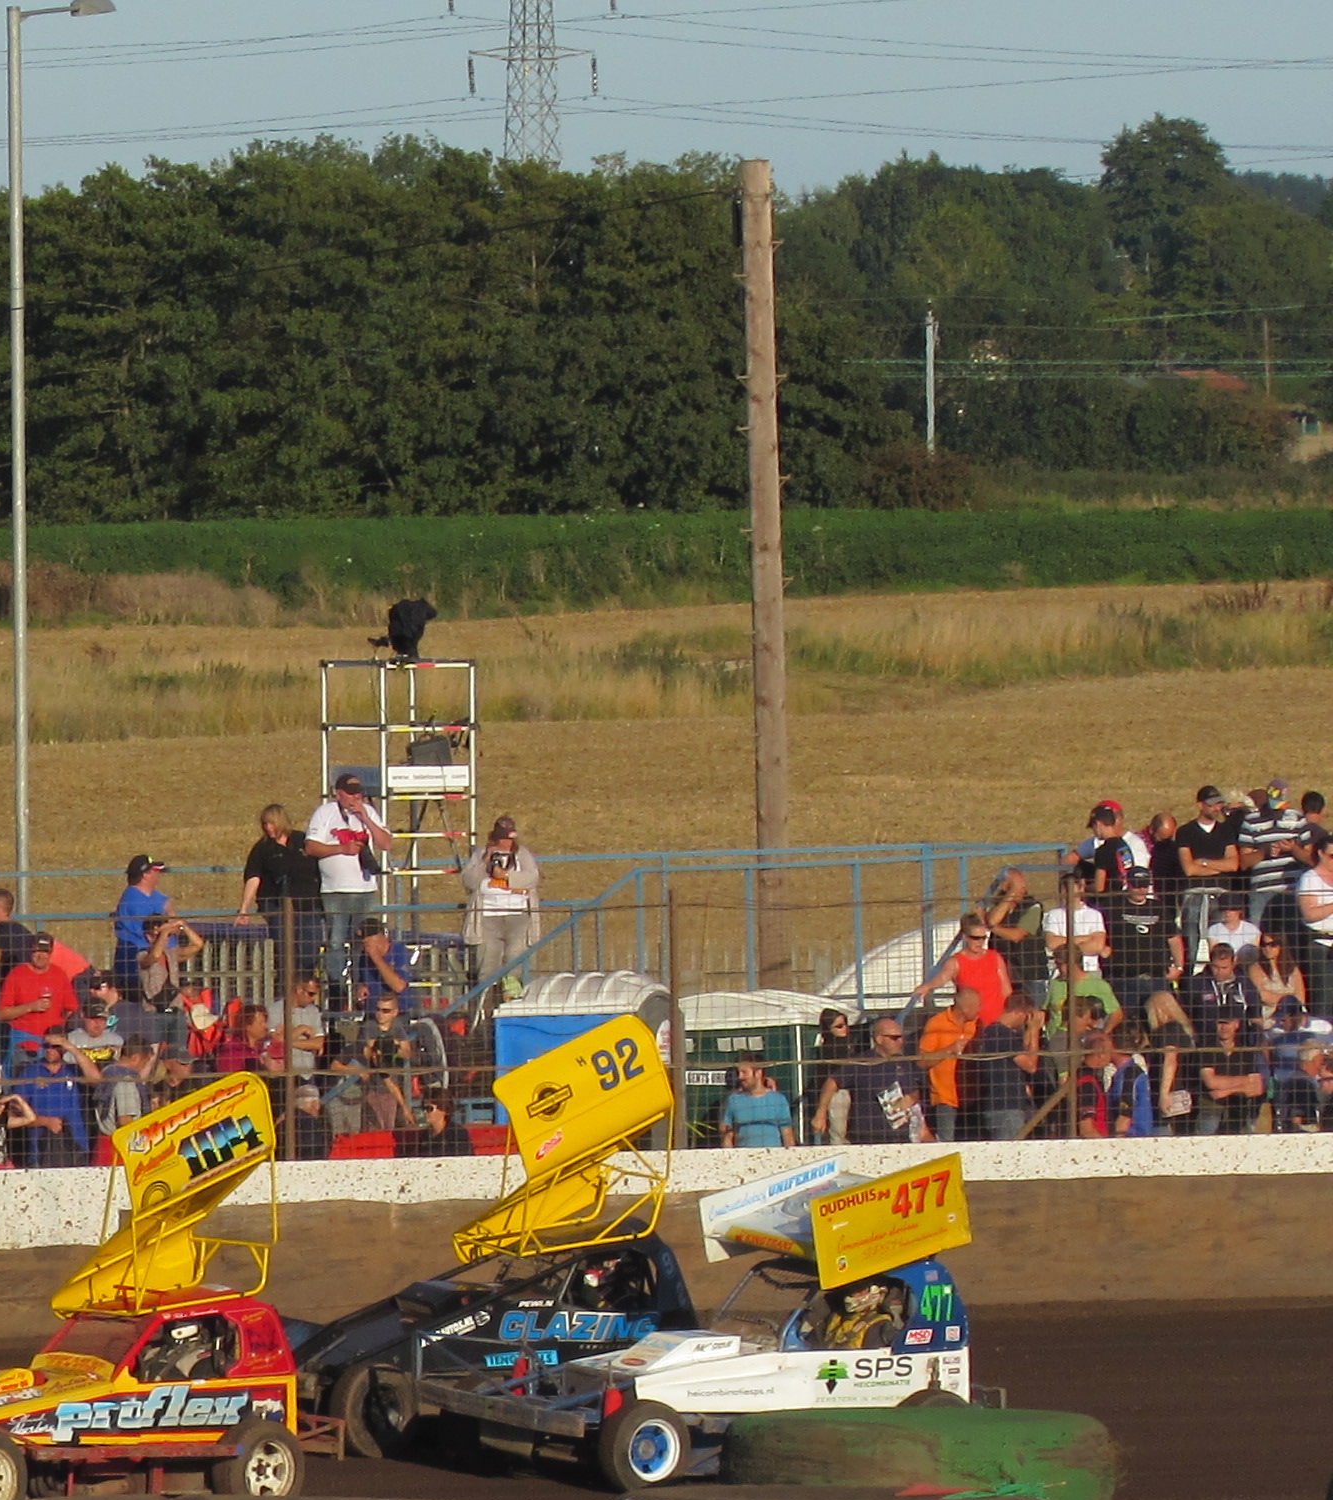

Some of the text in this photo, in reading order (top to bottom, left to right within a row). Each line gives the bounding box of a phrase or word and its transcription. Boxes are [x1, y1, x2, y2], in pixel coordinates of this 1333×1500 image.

[591, 1037, 645, 1091] 92
[819, 1188, 877, 1217] OUDHUIS
[891, 1169, 951, 1218] 477
[920, 1284, 953, 1321] 477
[499, 1309, 660, 1343] CLAZING
[905, 1330, 932, 1344] MSD
[854, 1356, 913, 1379] SPS
[51, 1385, 250, 1443] proflex
